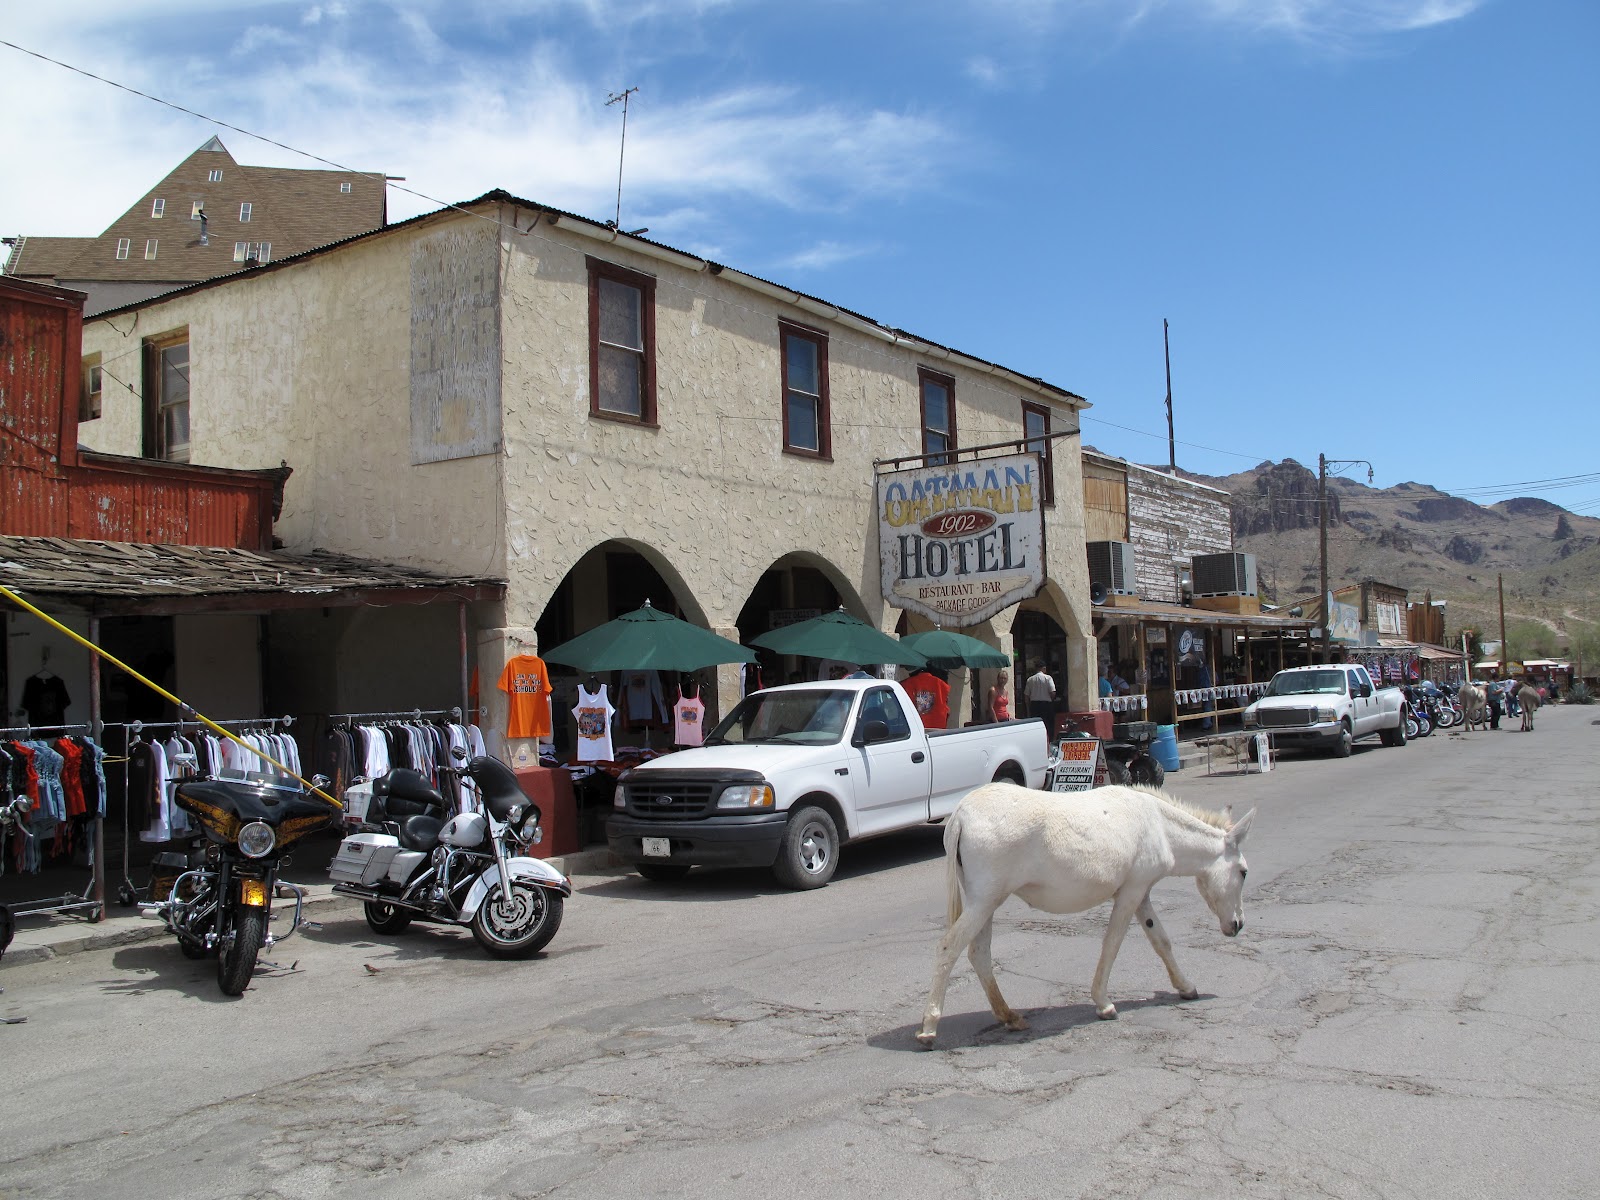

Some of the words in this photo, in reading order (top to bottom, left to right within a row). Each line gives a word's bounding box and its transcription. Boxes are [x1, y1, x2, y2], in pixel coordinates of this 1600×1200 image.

[885, 464, 1033, 527] OATMAN
[937, 515, 976, 535] 1902
[897, 522, 1026, 579] HOTEL
[919, 583, 975, 599] RESTAURANT
[981, 581, 1001, 594] BAR
[936, 599, 966, 612] PACKAGE
[967, 597, 990, 610] GOODS
[1063, 751, 1091, 761] HOTEL
[1060, 766, 1092, 774] RESTAURANT
[1057, 784, 1088, 792] T-SHIRTS
